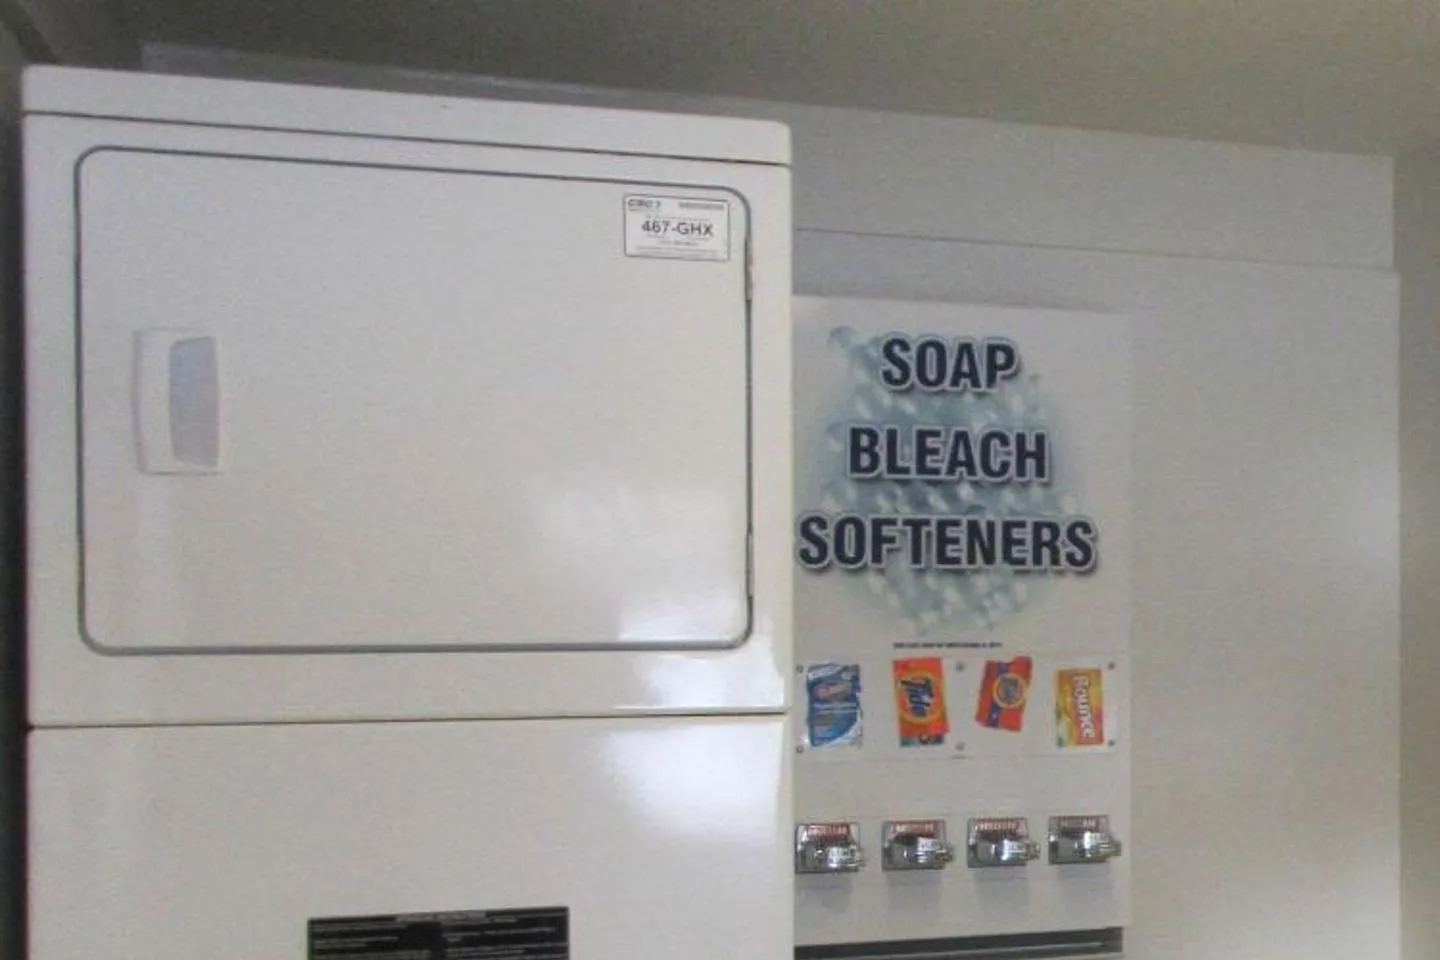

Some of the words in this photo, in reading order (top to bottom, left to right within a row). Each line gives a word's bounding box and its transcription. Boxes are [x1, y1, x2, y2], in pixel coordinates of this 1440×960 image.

[880, 336, 1019, 390] SOAP
[848, 426, 1049, 481] BLEACH
[798, 515, 1096, 569] SOFTENERS
